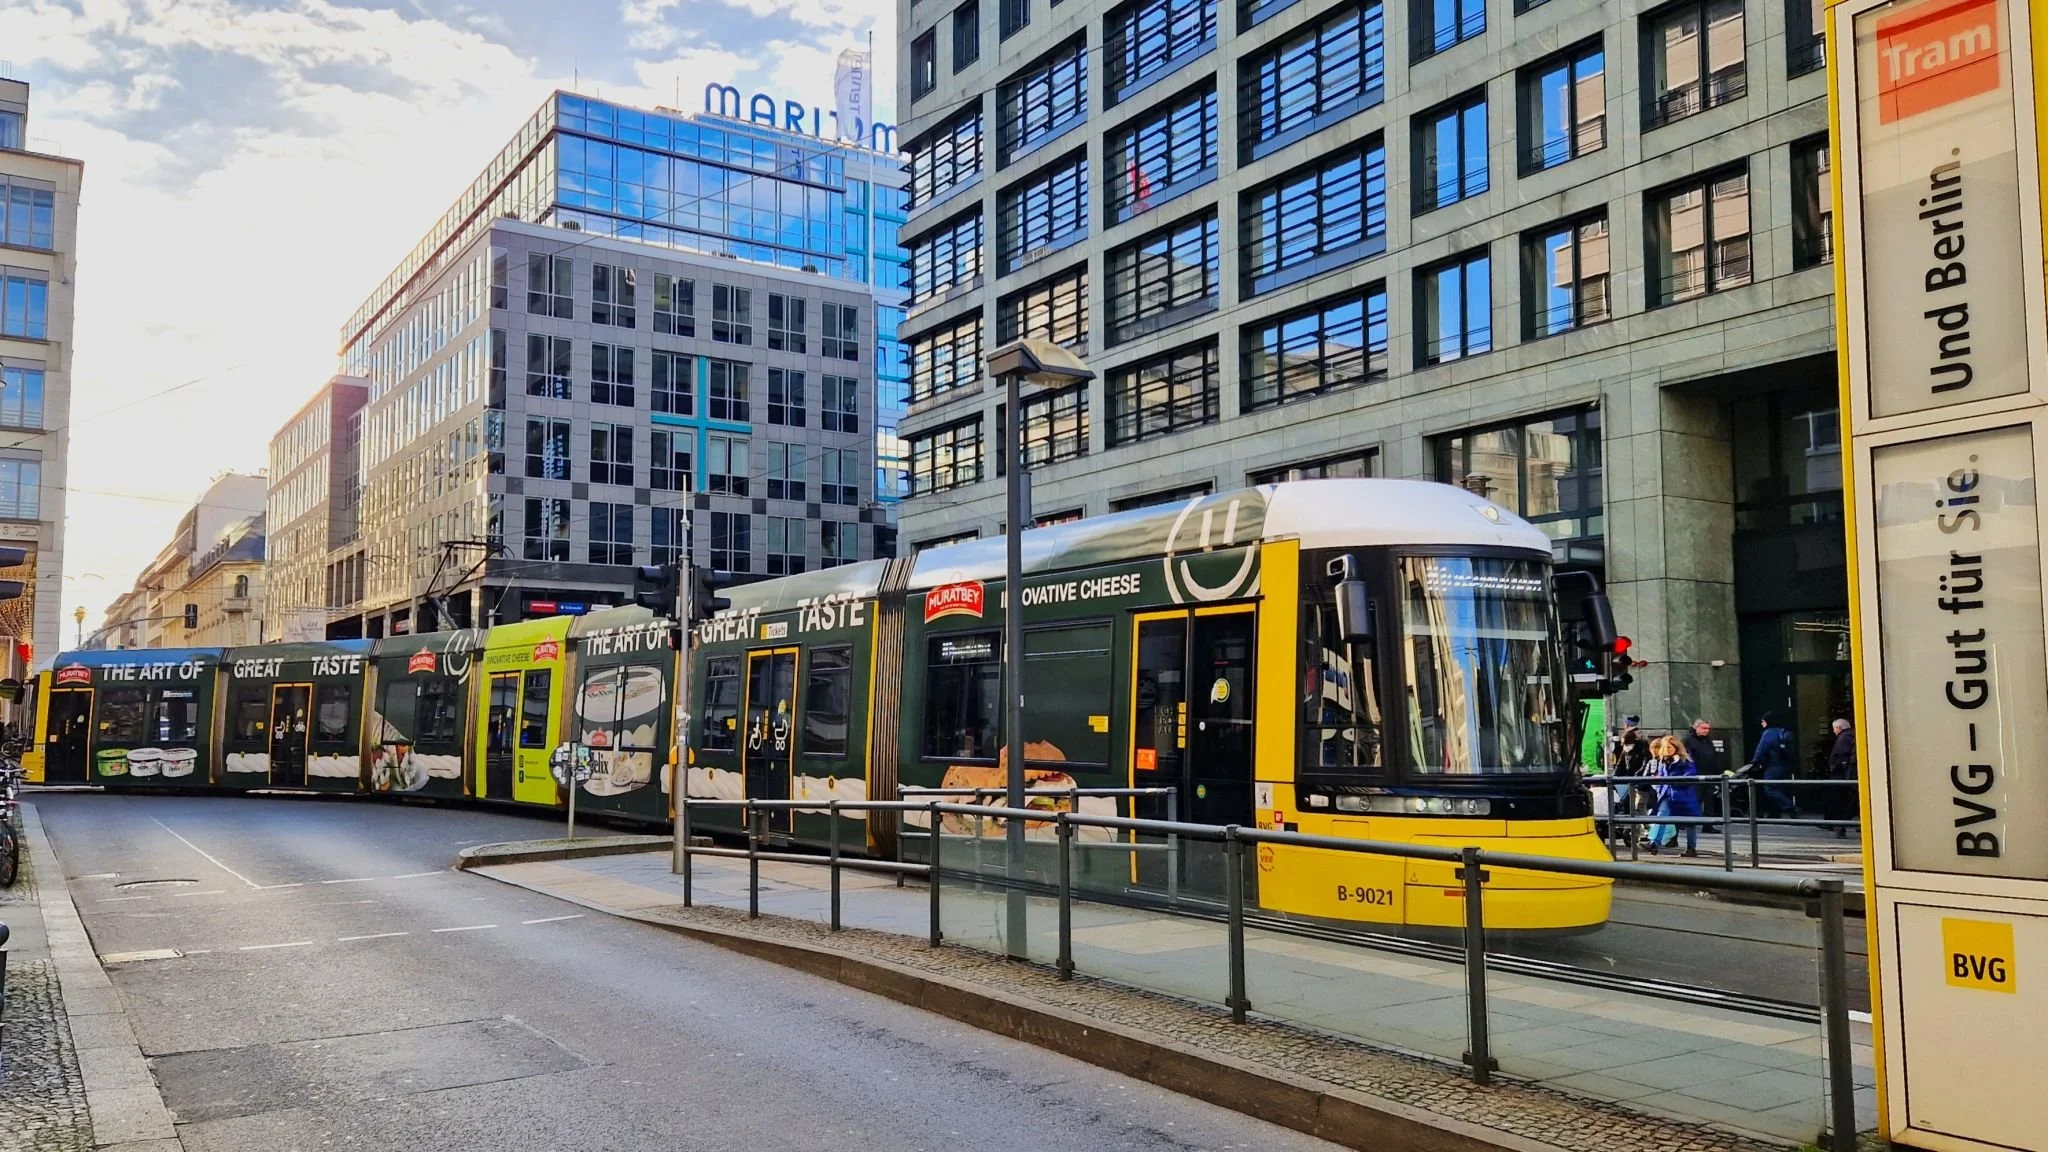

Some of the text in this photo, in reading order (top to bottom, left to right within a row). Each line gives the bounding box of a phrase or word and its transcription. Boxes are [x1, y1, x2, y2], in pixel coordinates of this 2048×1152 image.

[1882, 22, 1991, 83] Tram
[705, 82, 897, 152] MARIM
[1919, 147, 1973, 394] Und Berlin.
[1936, 454, 1980, 534] Sie.
[928, 587, 980, 611] MURATBEY
[1000, 573, 1141, 608] IOVATIVE CHEESE
[1938, 550, 1983, 615] für
[701, 591, 867, 644] GREAT TASTE
[768, 625, 786, 637] Tickets
[586, 620, 669, 657] THE ART OF
[101, 660, 205, 681] THE ART OF
[233, 654, 362, 678] GREAT TASTE
[486, 652, 531, 664] INNOVATIVE CHEESE
[1946, 628, 1989, 709] Gut
[1950, 764, 2000, 858] BVG
[1337, 885, 1393, 906] B-9021
[1953, 953, 2006, 983] BVG
